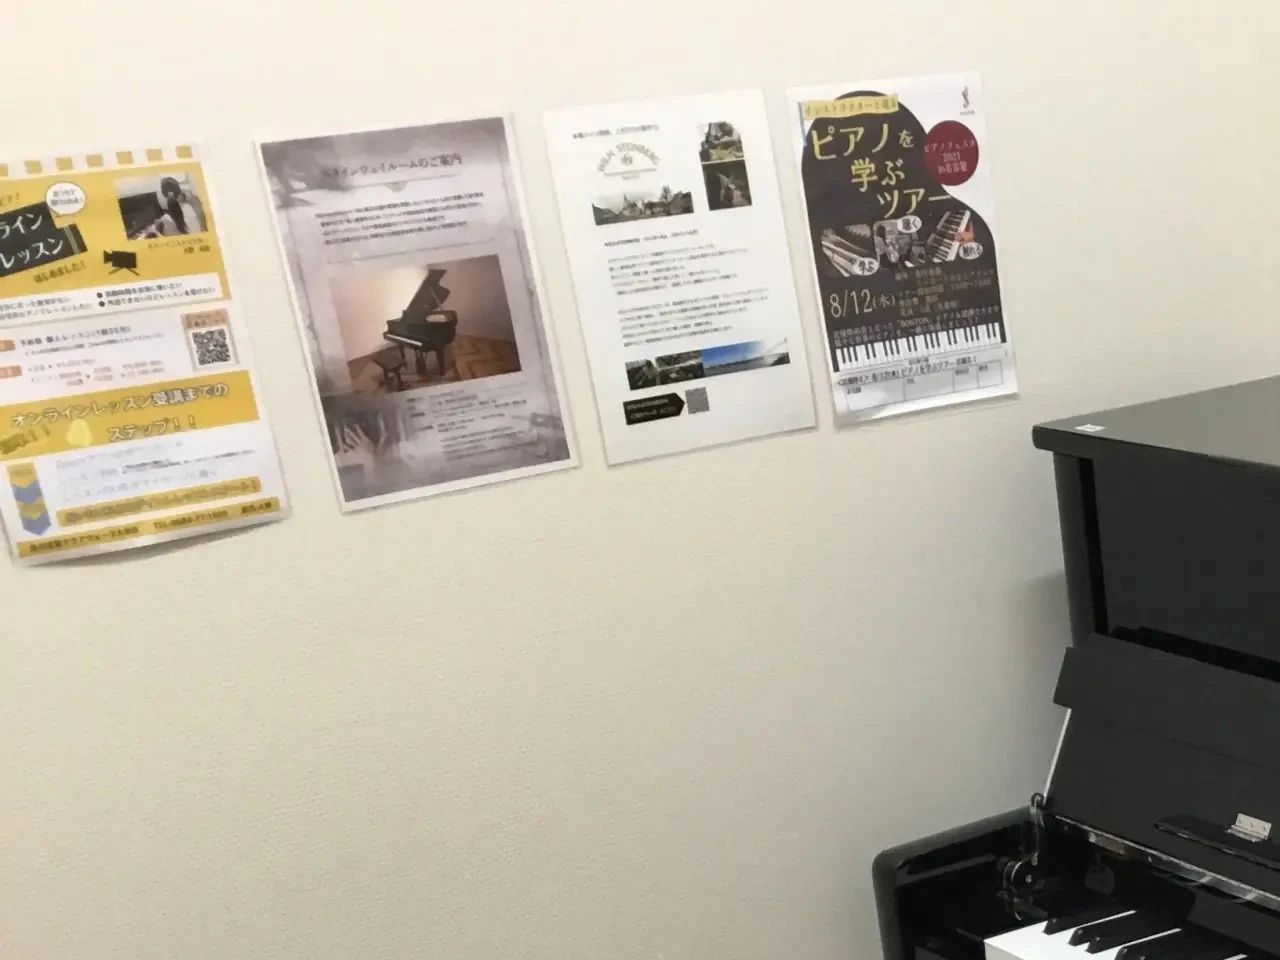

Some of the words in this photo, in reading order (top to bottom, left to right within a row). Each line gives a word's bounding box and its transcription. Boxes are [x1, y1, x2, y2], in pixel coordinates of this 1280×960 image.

[811, 123, 915, 160] ピアノを
[850, 157, 905, 192] 学ぶ
[877, 187, 952, 219] ツアー
[0, 237, 64, 269] レッスン
[828, 288, 896, 319] 8/12(木)
